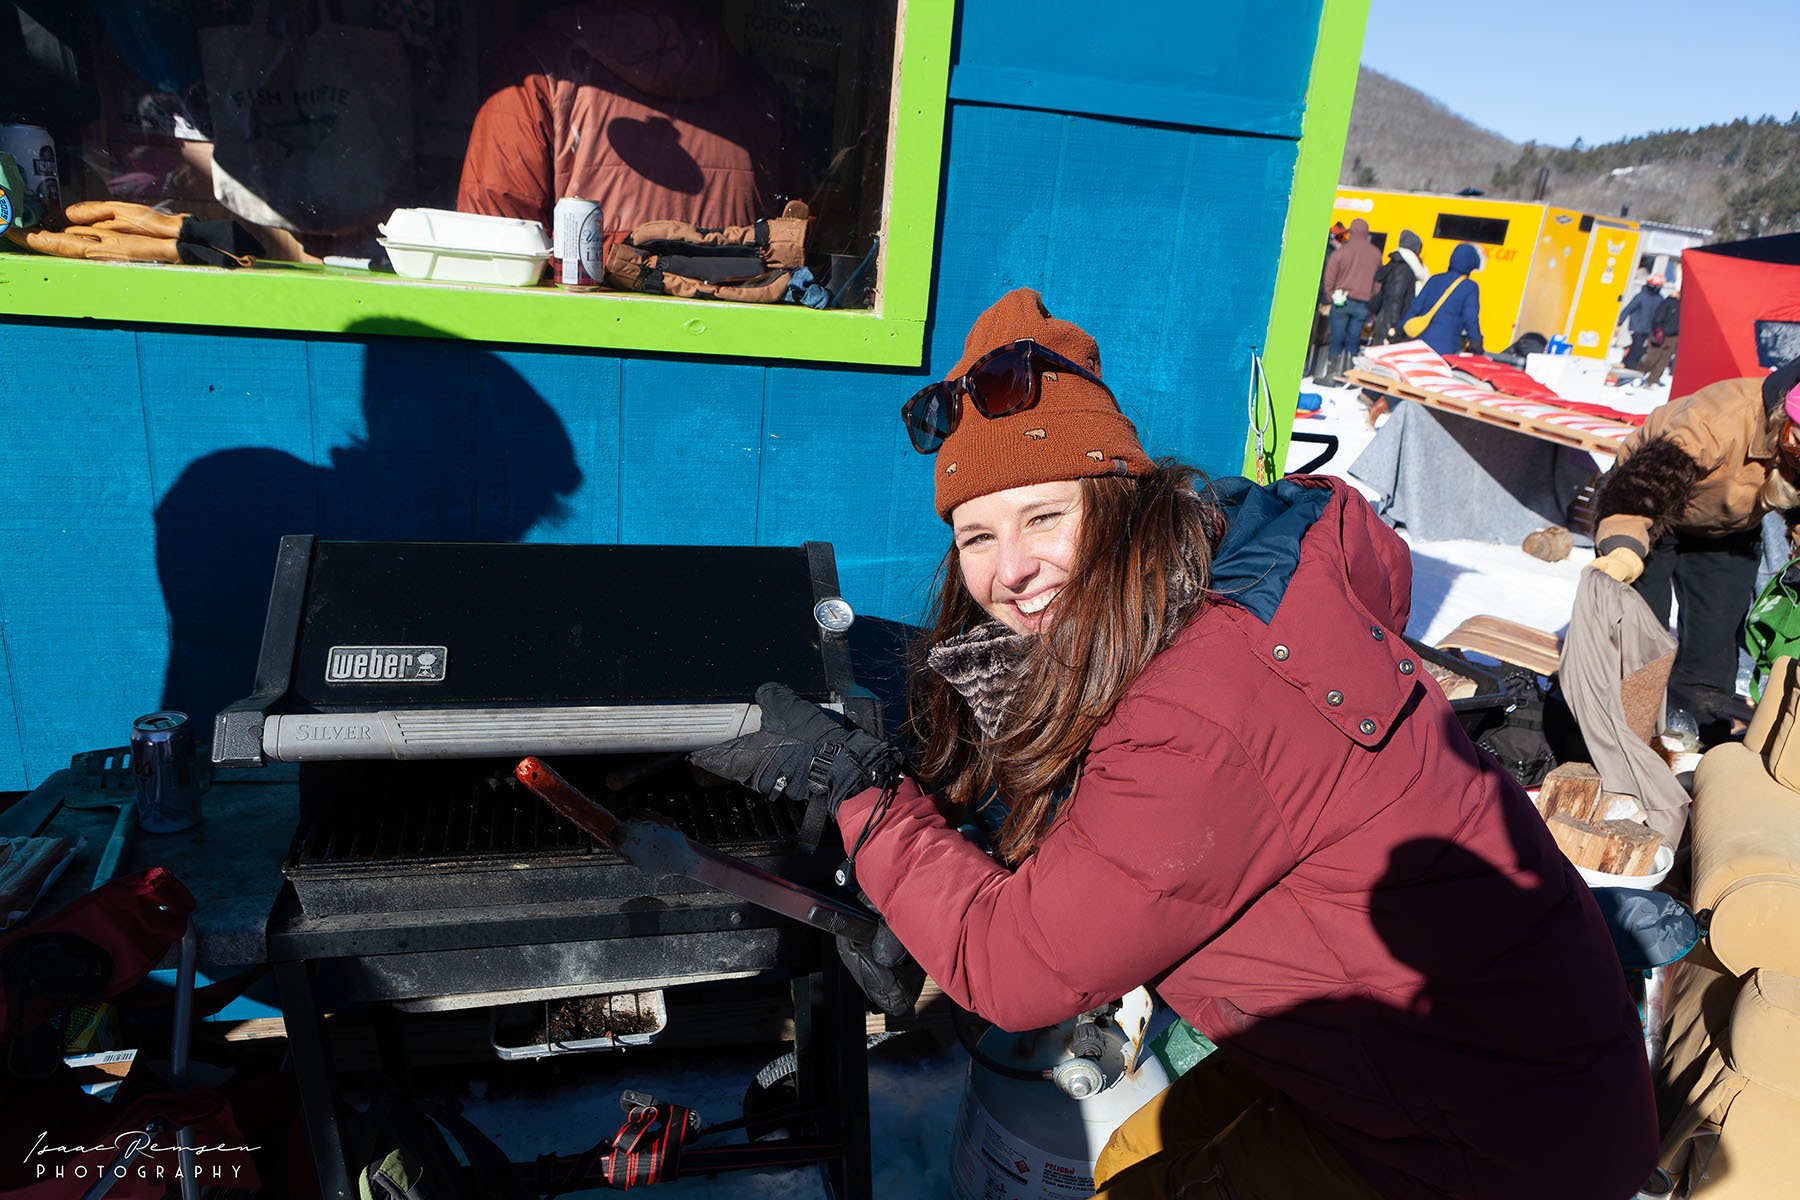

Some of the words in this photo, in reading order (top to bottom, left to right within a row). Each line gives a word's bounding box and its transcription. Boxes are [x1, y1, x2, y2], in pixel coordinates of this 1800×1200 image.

[232, 88, 282, 107] FISH
[332, 649, 413, 679] weber
[296, 724, 372, 742] SILVER
